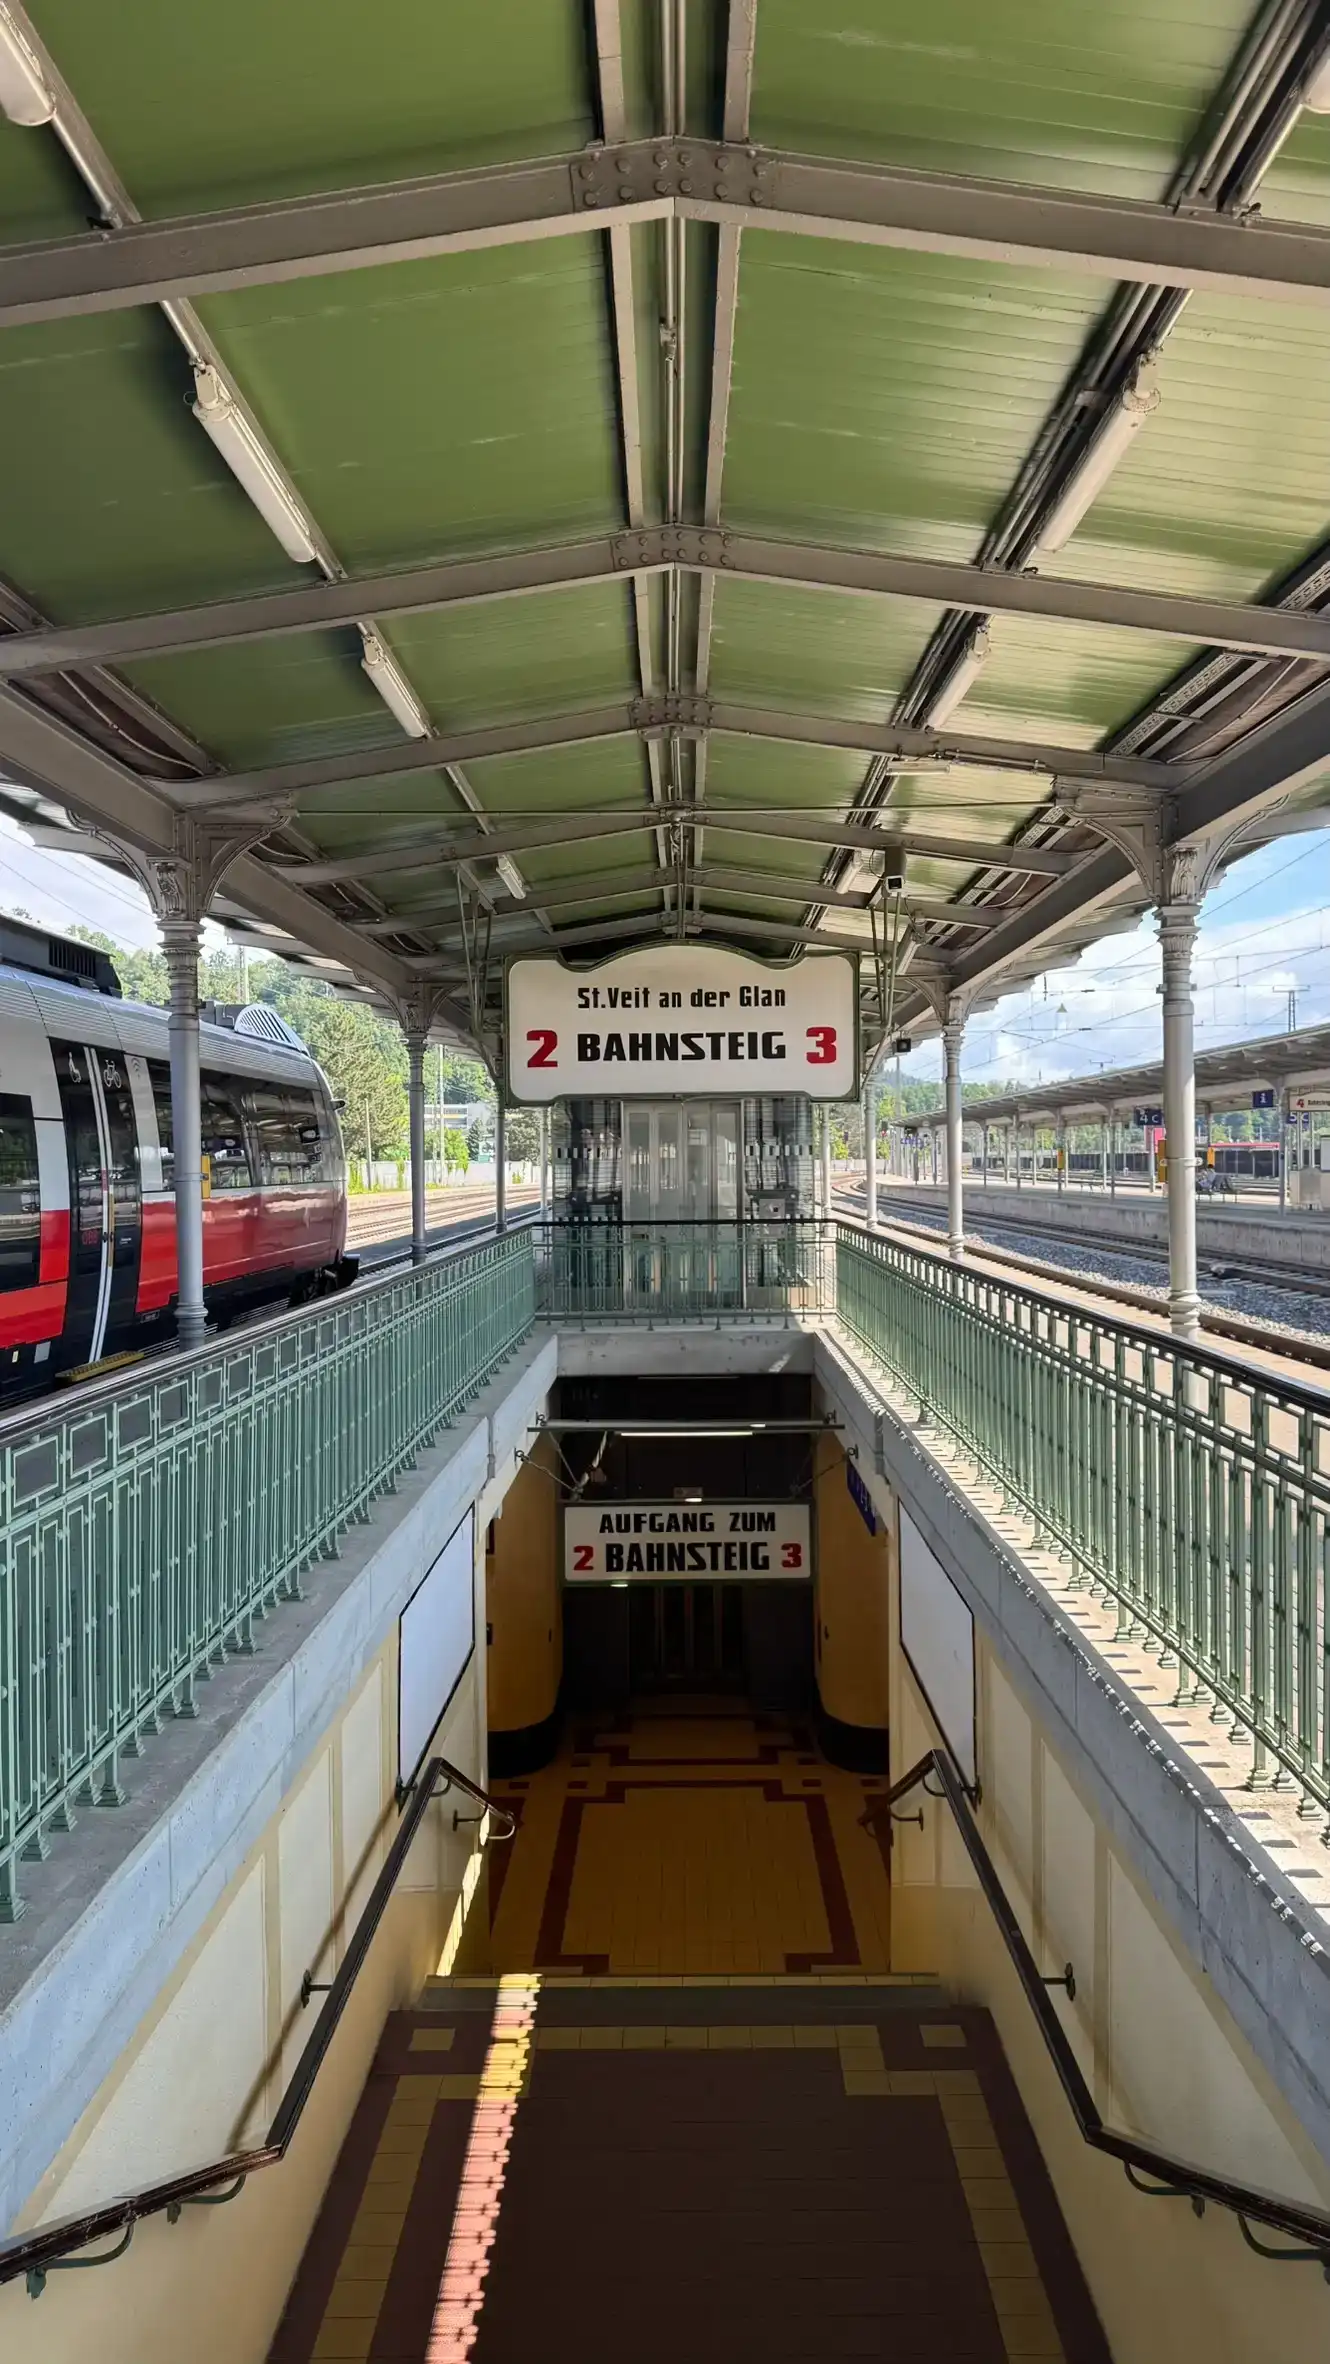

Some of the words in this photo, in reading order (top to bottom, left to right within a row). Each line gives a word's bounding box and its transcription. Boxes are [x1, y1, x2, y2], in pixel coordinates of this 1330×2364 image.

[659, 992, 681, 1008] an
[690, 989, 730, 1007] der
[739, 986, 785, 1006] Glan
[526, 1029, 558, 1068] 2
[577, 1031, 786, 1062] BAHNSTEIG
[805, 1026, 837, 1064] 3
[1296, 1099, 1304, 1108] 4
[1140, 1114, 1148, 1124] 4
[600, 1512, 715, 1533] AUFGANG
[729, 1512, 776, 1532] ZUM
[573, 1545, 594, 1571] 2
[605, 1542, 770, 1572] BAHNSTEIG
[781, 1543, 802, 1568] 3
